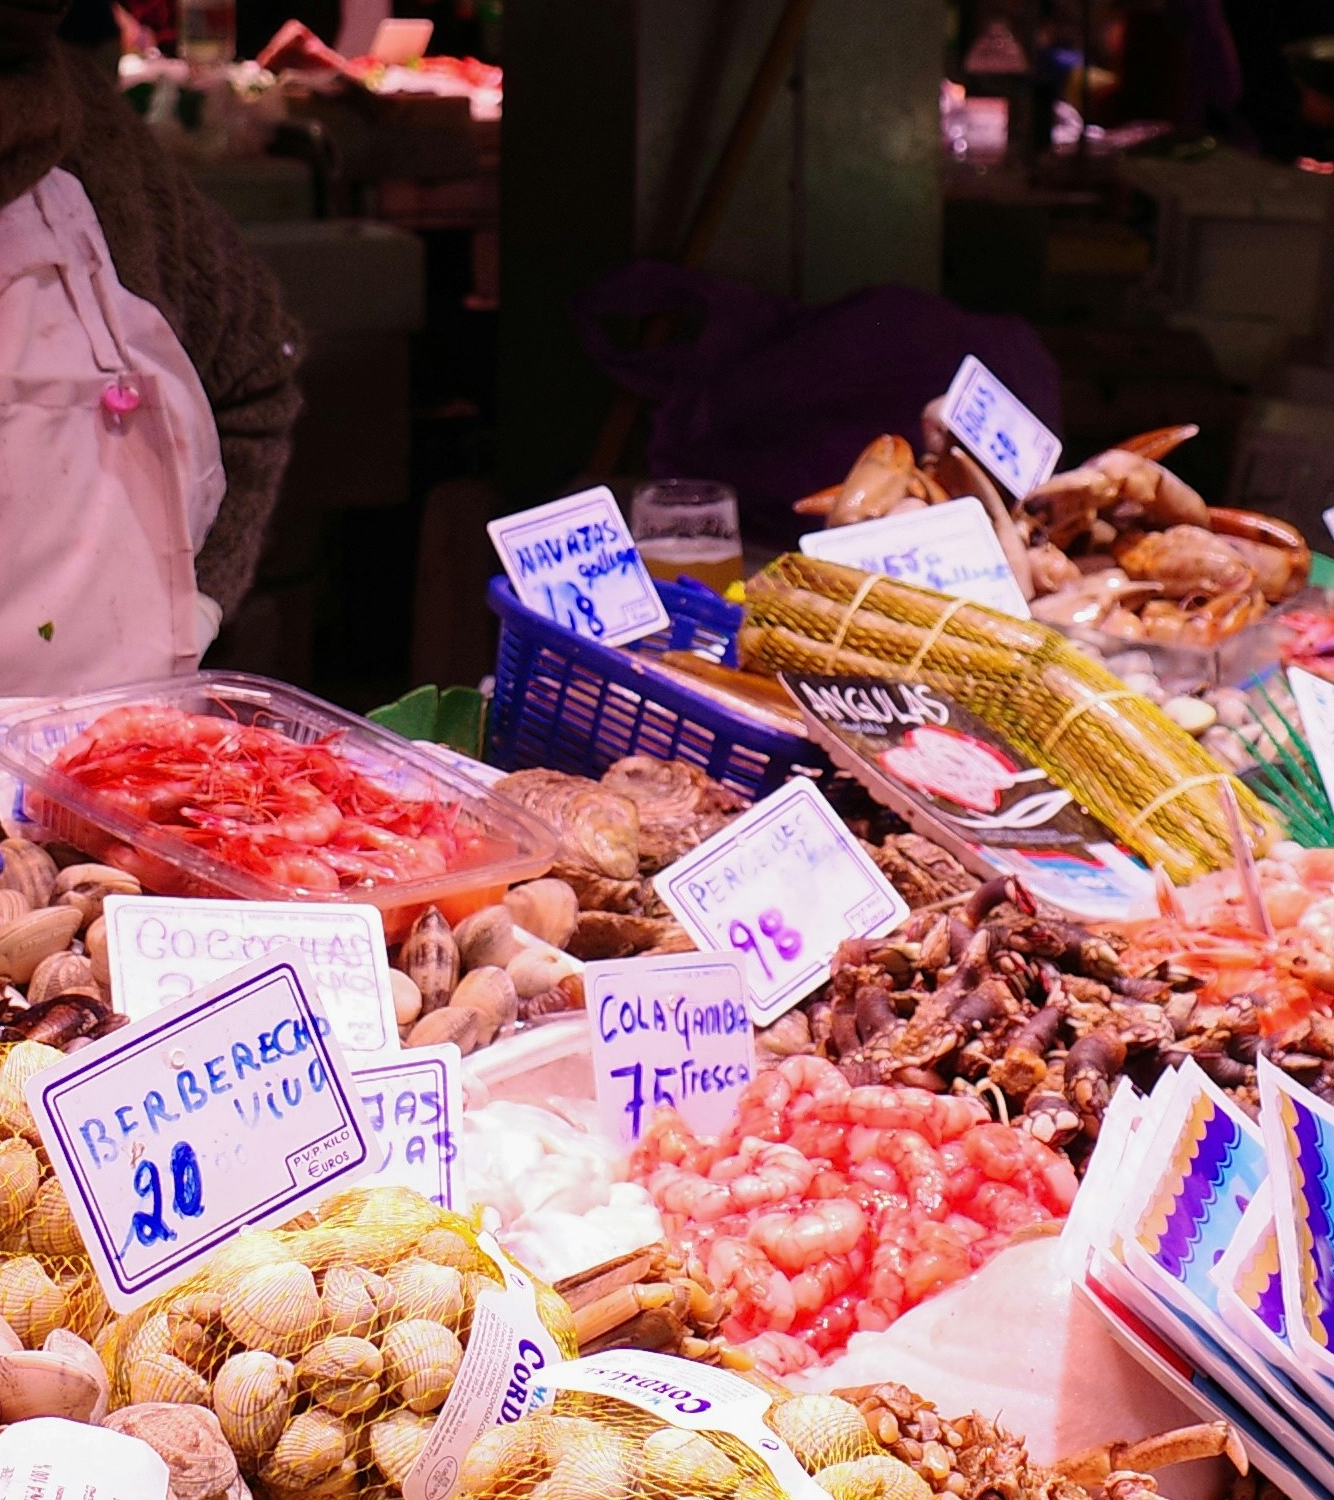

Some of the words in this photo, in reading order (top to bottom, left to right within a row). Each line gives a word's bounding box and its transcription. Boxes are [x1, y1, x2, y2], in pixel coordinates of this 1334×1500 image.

[800, 680, 949, 727] ANGULAS
[729, 907, 802, 981] 98
[600, 994, 667, 1043] COLA
[674, 996, 749, 1051] GAMBA
[79, 1016, 331, 1168] BERBERECHO
[323, 1130, 350, 1153] KILO
[115, 1140, 205, 1260] 20
